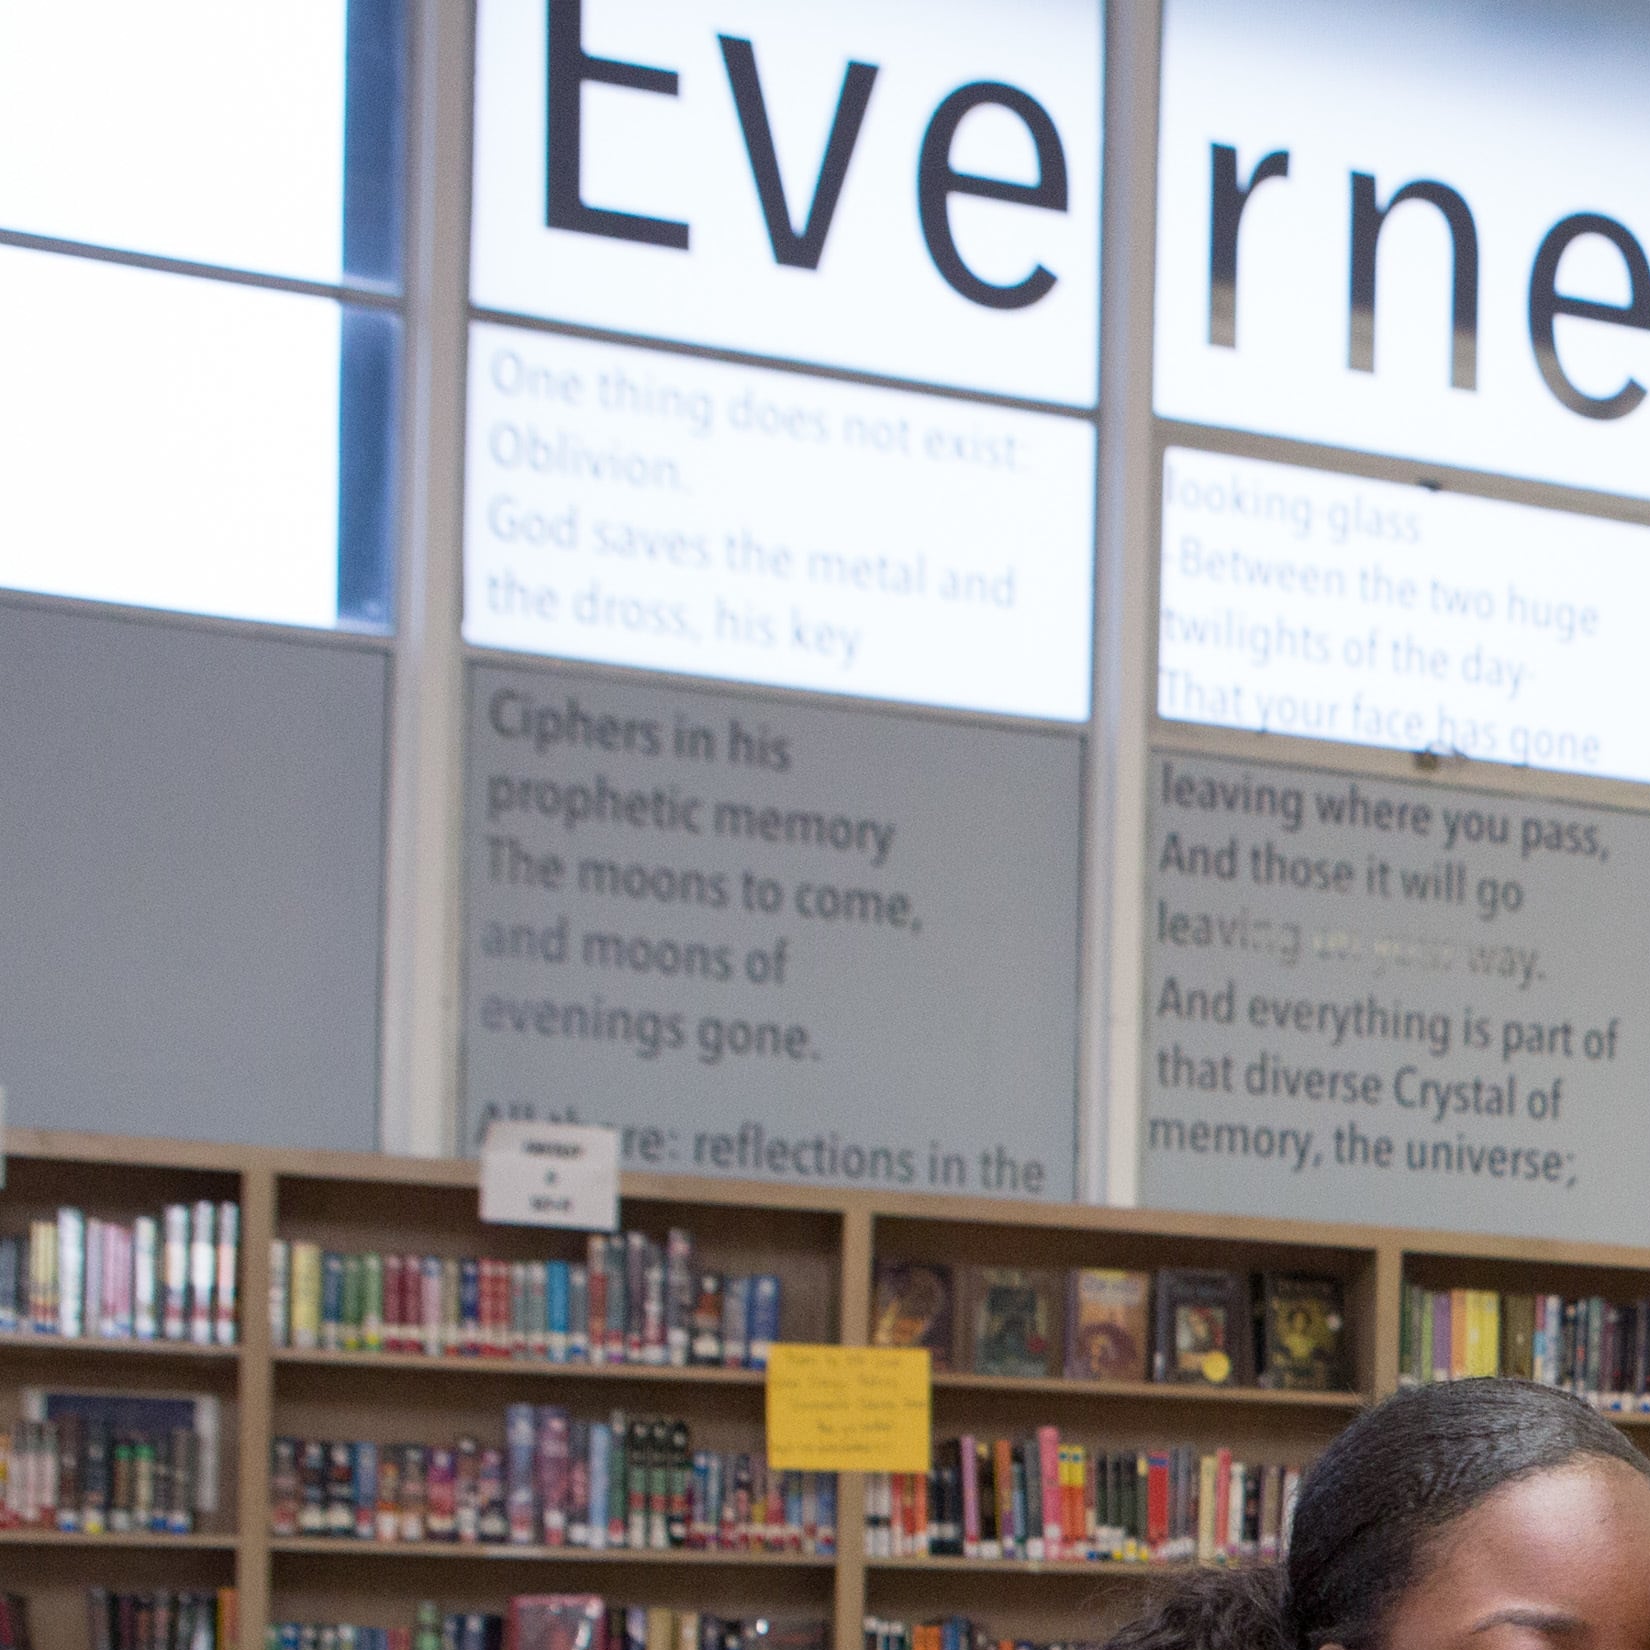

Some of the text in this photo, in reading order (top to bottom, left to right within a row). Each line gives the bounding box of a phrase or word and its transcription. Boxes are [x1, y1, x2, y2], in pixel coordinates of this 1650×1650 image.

[489, 348, 584, 405] One
[597, 367, 713, 437] thing
[727, 388, 828, 442] does
[843, 416, 909, 454] not
[486, 493, 1015, 608] God saves the metal and
[486, 568, 860, 670] the dross, his key
[1358, 563, 1418, 609] the
[1429, 578, 1495, 620] two
[1507, 583, 1598, 643] huge
[1342, 627, 1378, 667] of
[1390, 633, 1449, 679] the
[488, 688, 791, 772] Ciphers in his
[1166, 672, 1246, 711] That
[1256, 695, 1338, 731] your
[1352, 691, 1424, 744] face
[487, 774, 895, 867] prophetic memory
[1162, 762, 1608, 861] leaving where you pass,
[486, 835, 565, 890] The
[578, 858, 729, 909] moons
[741, 870, 783, 914] to
[1159, 831, 1523, 921] And those it will go
[482, 916, 788, 984] and moons of
[481, 995, 819, 1065] evenings gone.
[1157, 976, 1619, 1062] And everything is part of
[1157, 1043, 1563, 1123] that diverse Crystal of
[693, 1121, 915, 1183] reflections
[928, 1140, 966, 1186] in
[979, 1144, 1045, 1194] the
[1148, 1118, 1576, 1188] memory, the universe;
